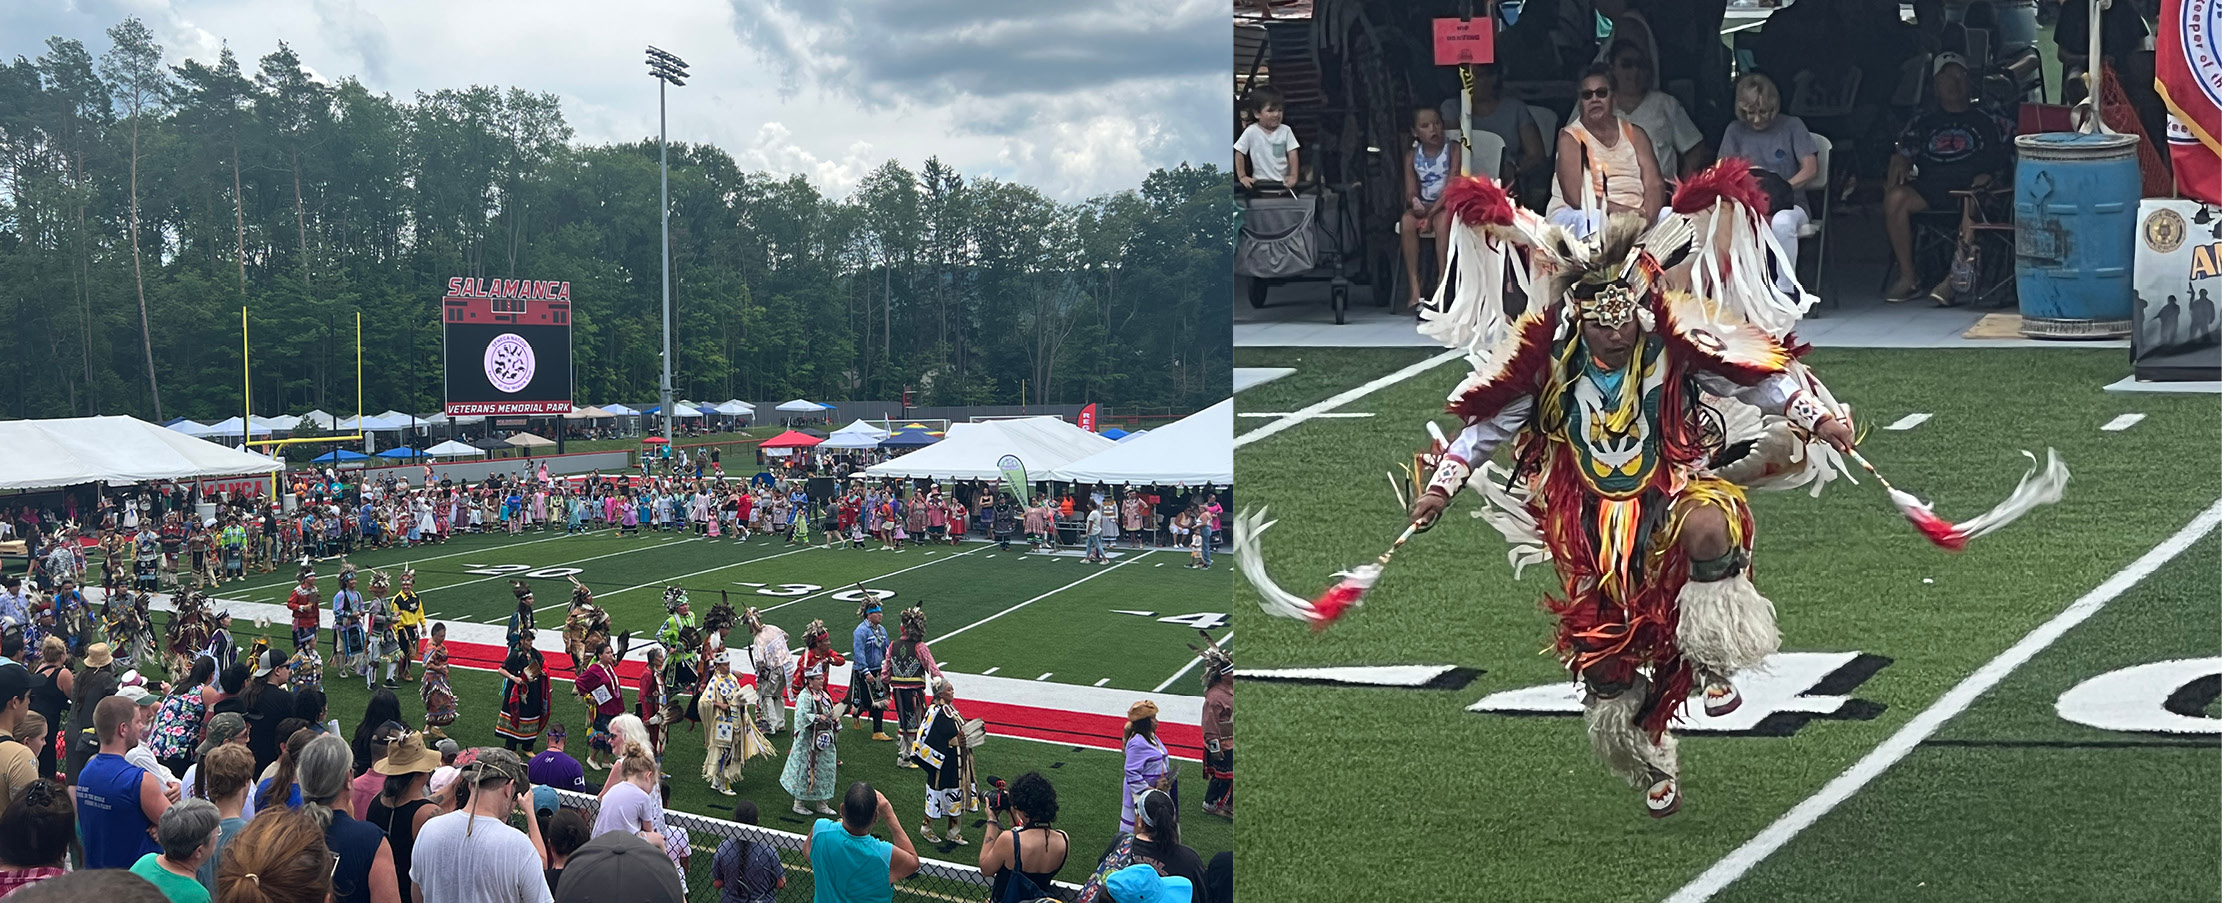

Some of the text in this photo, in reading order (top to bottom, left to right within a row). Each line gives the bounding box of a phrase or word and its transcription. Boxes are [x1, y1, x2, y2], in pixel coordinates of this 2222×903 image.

[2200, 55, 2215, 68] of
[447, 277, 570, 299] SALAMANCA
[448, 403, 570, 414] VETERANS MEMORIAL PARK
